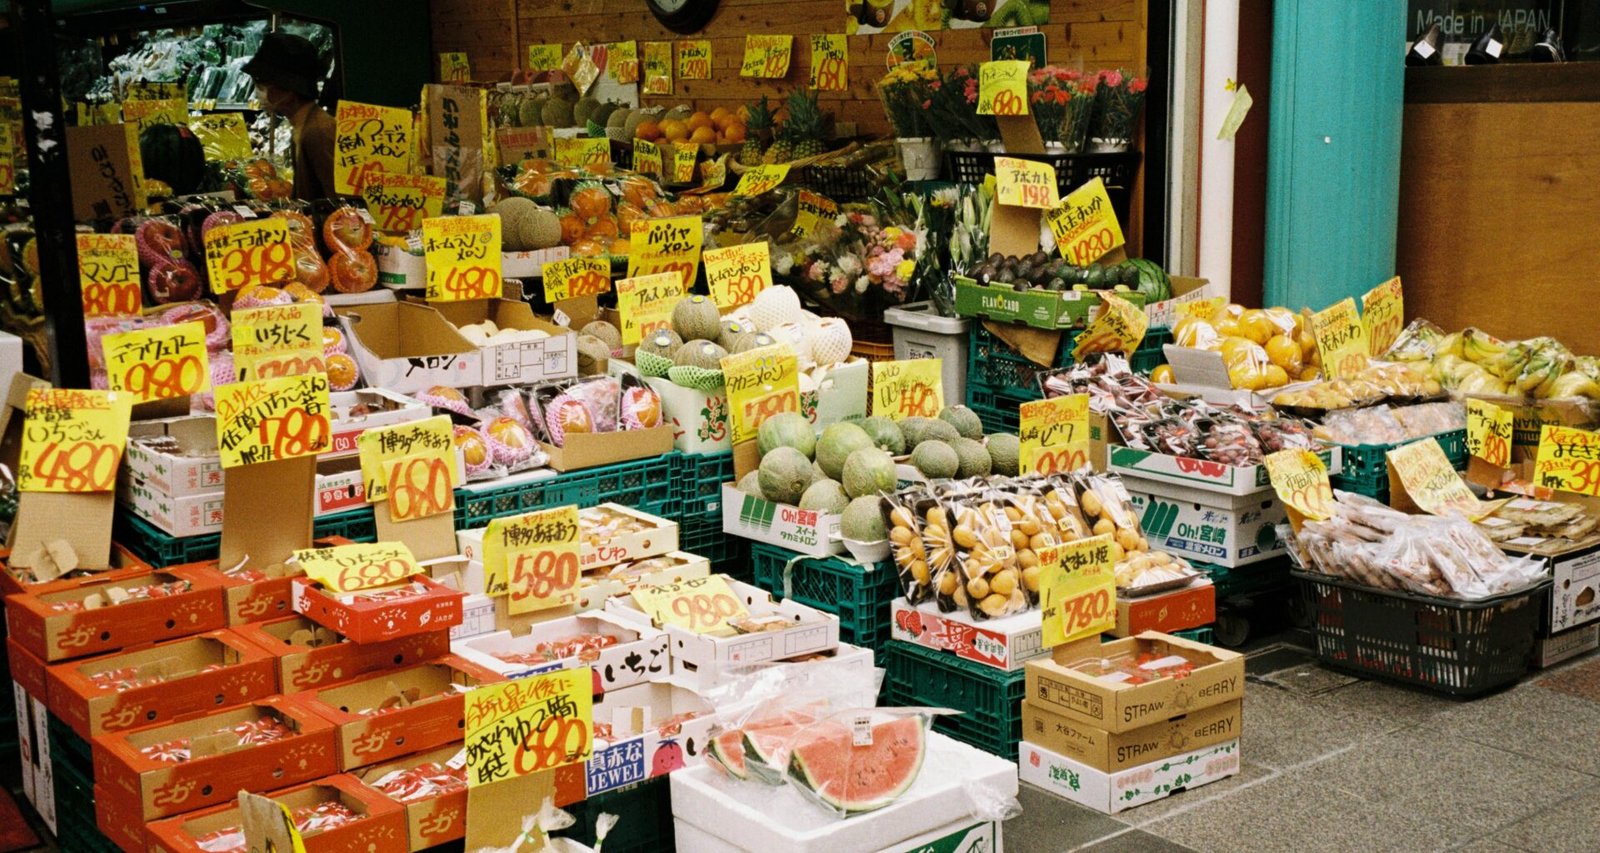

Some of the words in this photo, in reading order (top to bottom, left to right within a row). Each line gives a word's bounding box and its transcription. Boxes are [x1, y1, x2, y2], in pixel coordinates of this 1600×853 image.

[1416, 9, 1465, 35] Made
[1470, 10, 1485, 34] in
[1497, 9, 1550, 34] JAPAN
[817, 58, 848, 90] 680
[992, 89, 1023, 115] 680
[1022, 185, 1050, 207] 198
[232, 228, 287, 249] デコポン
[426, 234, 476, 253] ホームラン
[648, 223, 691, 245] パパイヤ
[456, 245, 487, 261] メロン
[660, 242, 696, 254] メロン
[83, 262, 140, 283] マンゴー
[445, 266, 500, 299] 480
[83, 283, 142, 316] 800
[727, 275, 765, 306] 580
[254, 323, 312, 346] いちじく
[123, 354, 205, 400] 980
[405, 353, 458, 379] メロン
[27, 421, 105, 443] いちごさん
[1041, 422, 1074, 447] ビワ
[33, 441, 121, 491] 480
[387, 457, 452, 519] 680
[781, 508, 818, 527] Oh!宮崎
[502, 519, 578, 548] 博多あまおう
[1177, 522, 1227, 546] Oh!宮崎
[597, 545, 627, 562] びわ
[338, 559, 411, 592] 680
[511, 551, 579, 601] 580
[671, 592, 739, 630] 980
[1065, 589, 1110, 634] 780
[605, 642, 669, 683] いちご
[1198, 675, 1237, 699] BERRY
[1123, 700, 1165, 723] STRAW
[1193, 716, 1235, 739] BERRY
[514, 716, 587, 776] 680
[588, 741, 643, 776] 真赤な
[1117, 741, 1159, 764] STRAW
[588, 763, 643, 794] JEWEL
